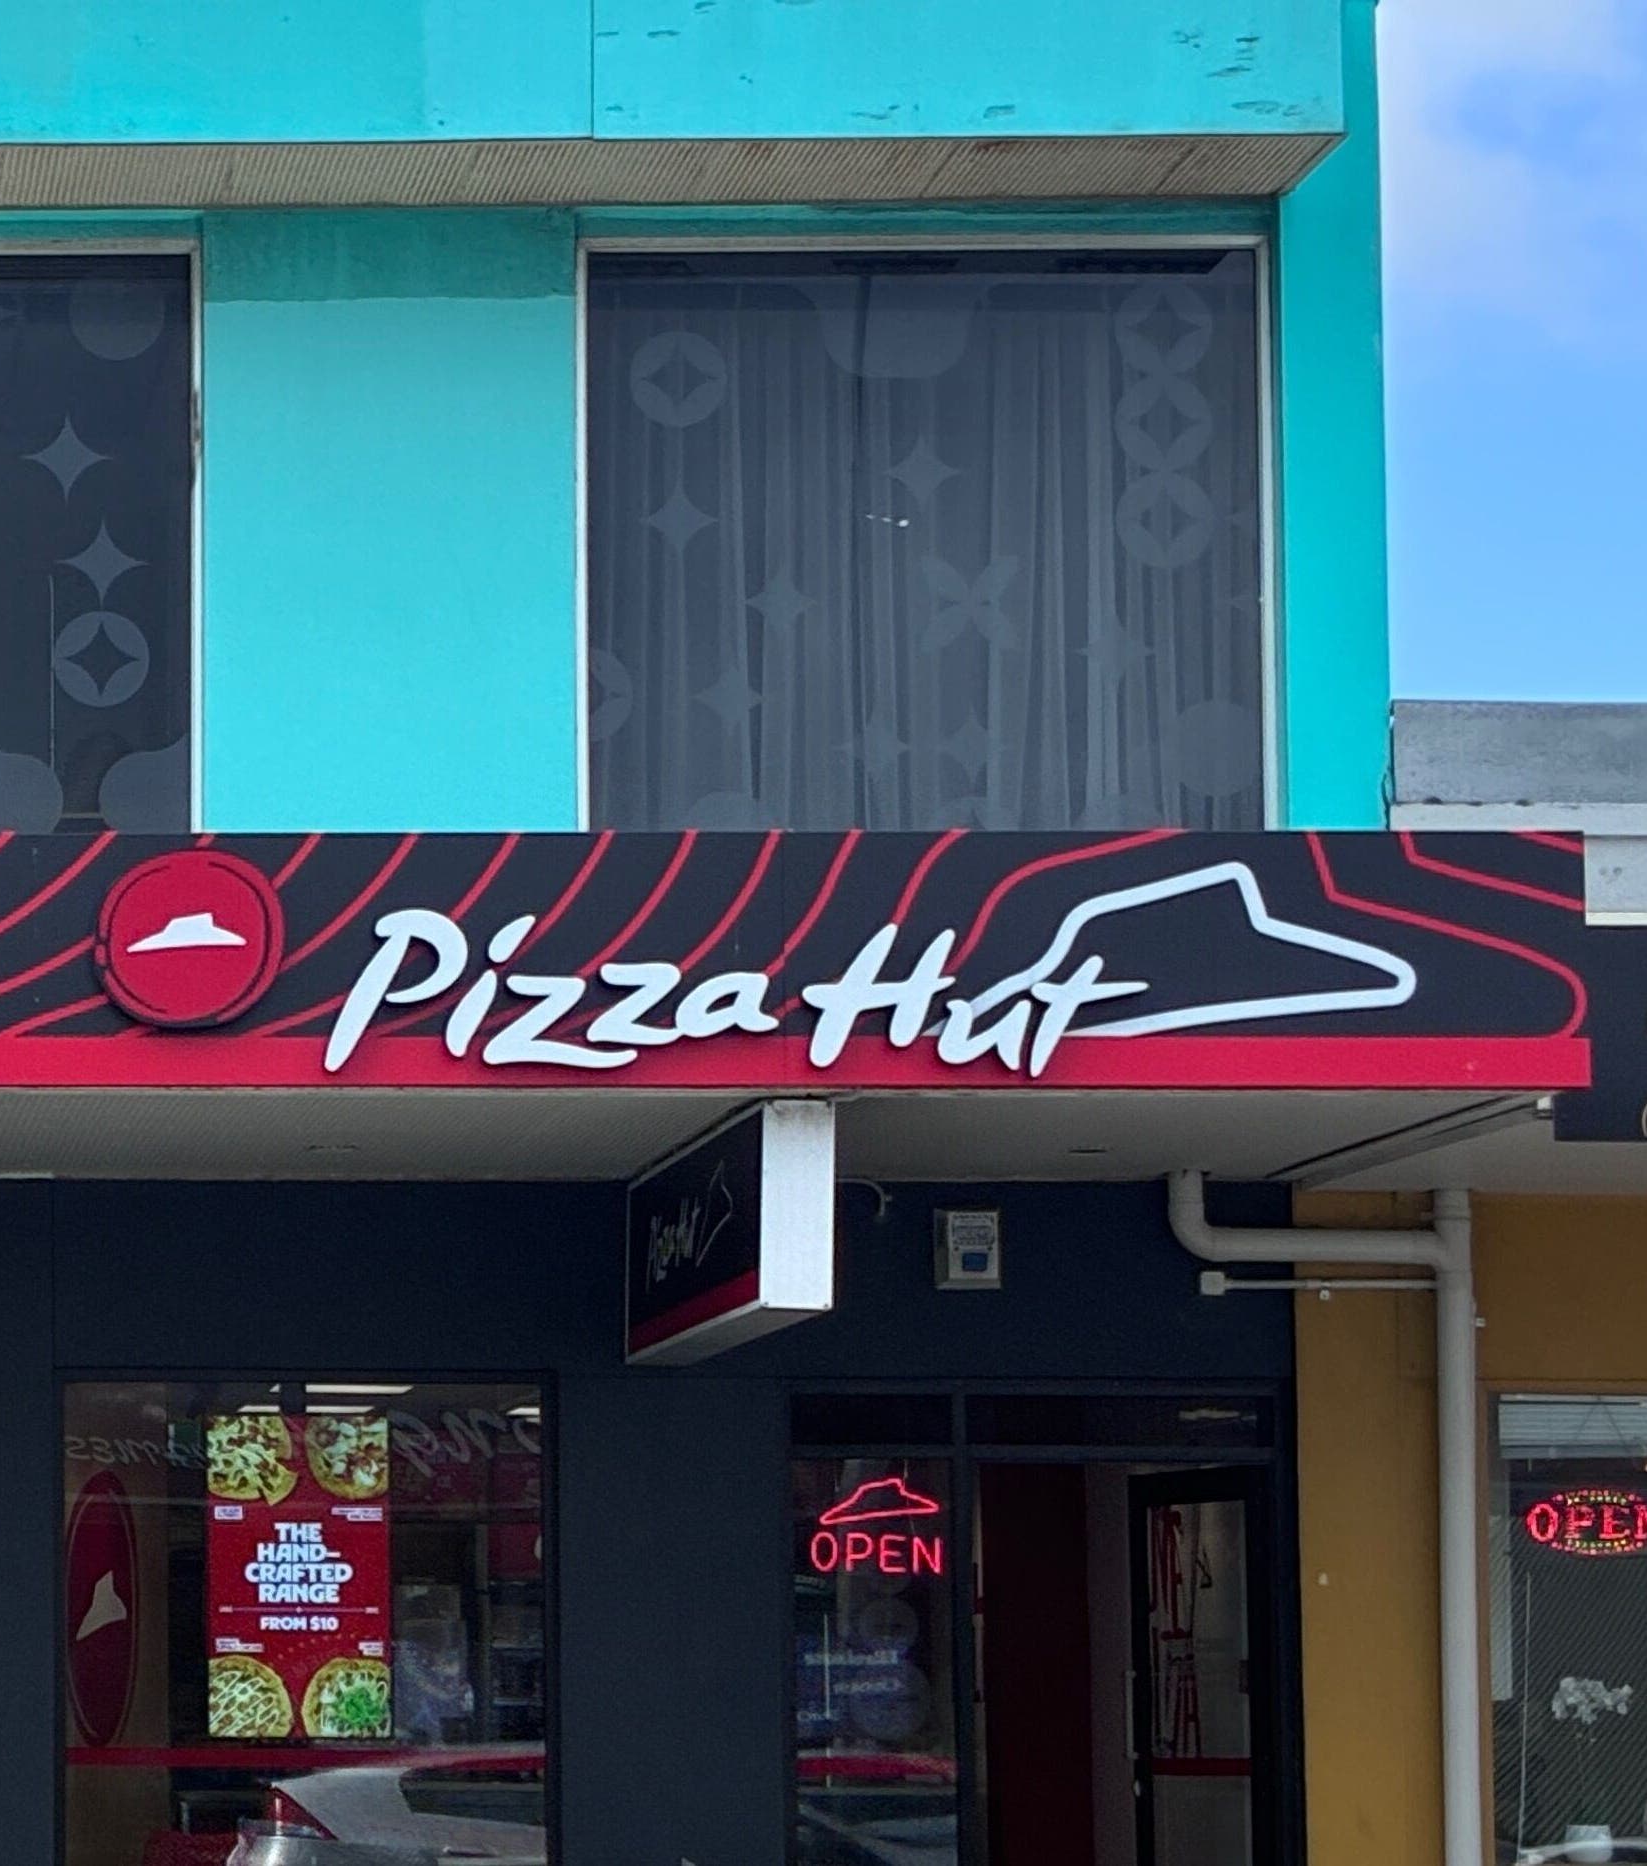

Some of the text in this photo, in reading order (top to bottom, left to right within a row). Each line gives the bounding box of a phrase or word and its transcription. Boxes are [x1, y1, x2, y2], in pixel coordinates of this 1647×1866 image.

[323, 908, 1150, 1078] Pizza Hut
[274, 1522, 322, 1542] THE
[257, 1543, 341, 1562] HAND-
[810, 1530, 944, 1576] OPEN
[245, 1562, 353, 1583] CRAFTED
[258, 1583, 340, 1603] RANGE
[260, 1616, 339, 1631] FROM $10
